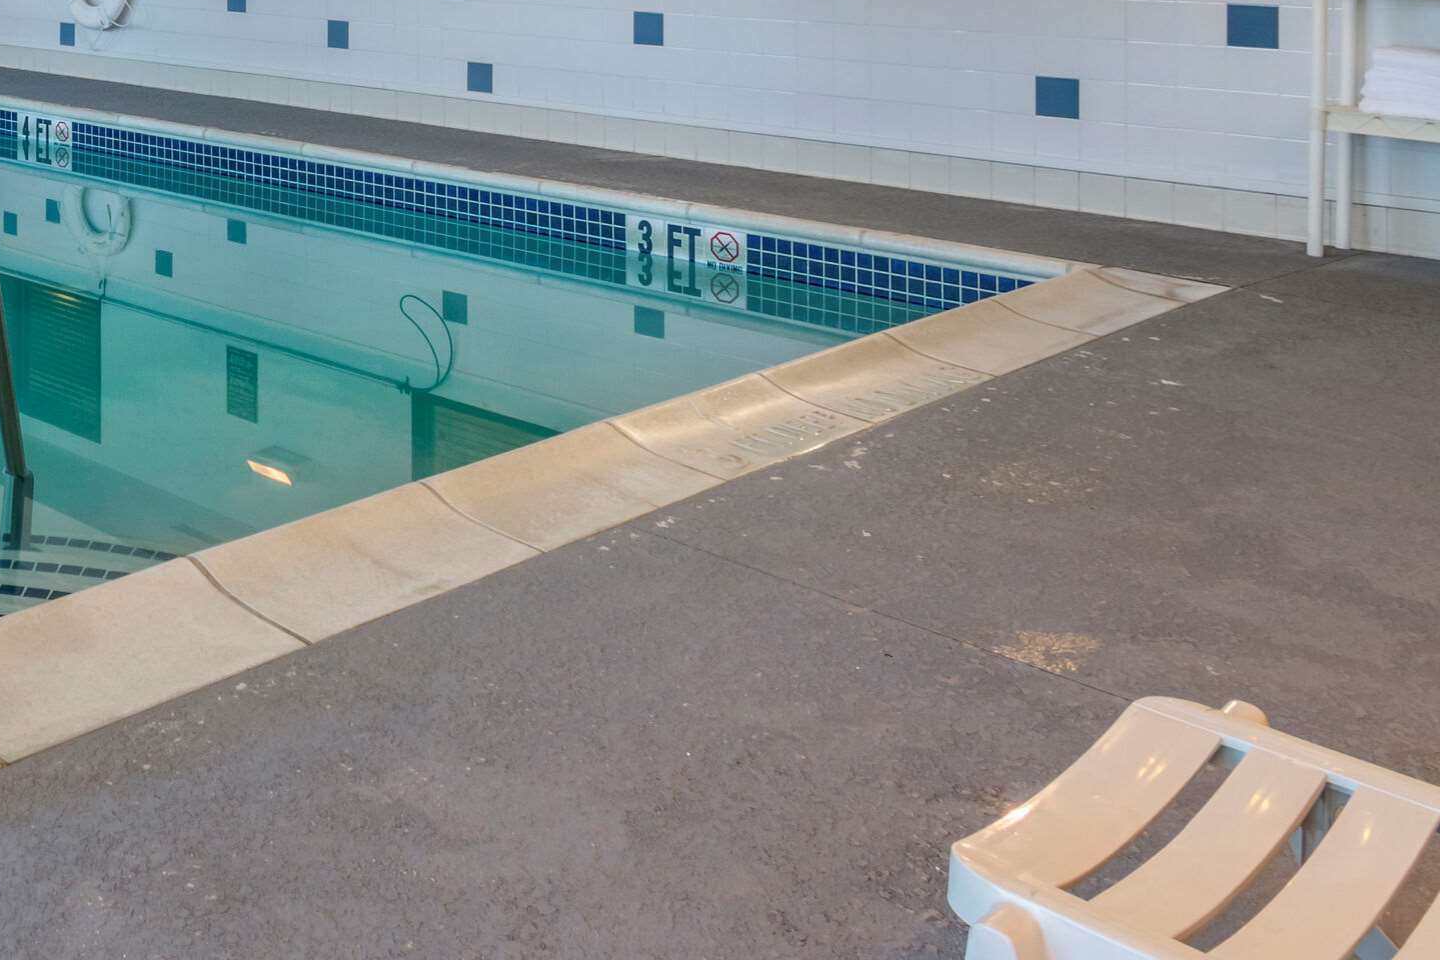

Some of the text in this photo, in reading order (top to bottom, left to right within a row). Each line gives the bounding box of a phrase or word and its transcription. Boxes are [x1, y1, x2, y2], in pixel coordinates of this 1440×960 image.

[22, 115, 52, 144] 4 FT
[637, 220, 702, 262] 3 FT
